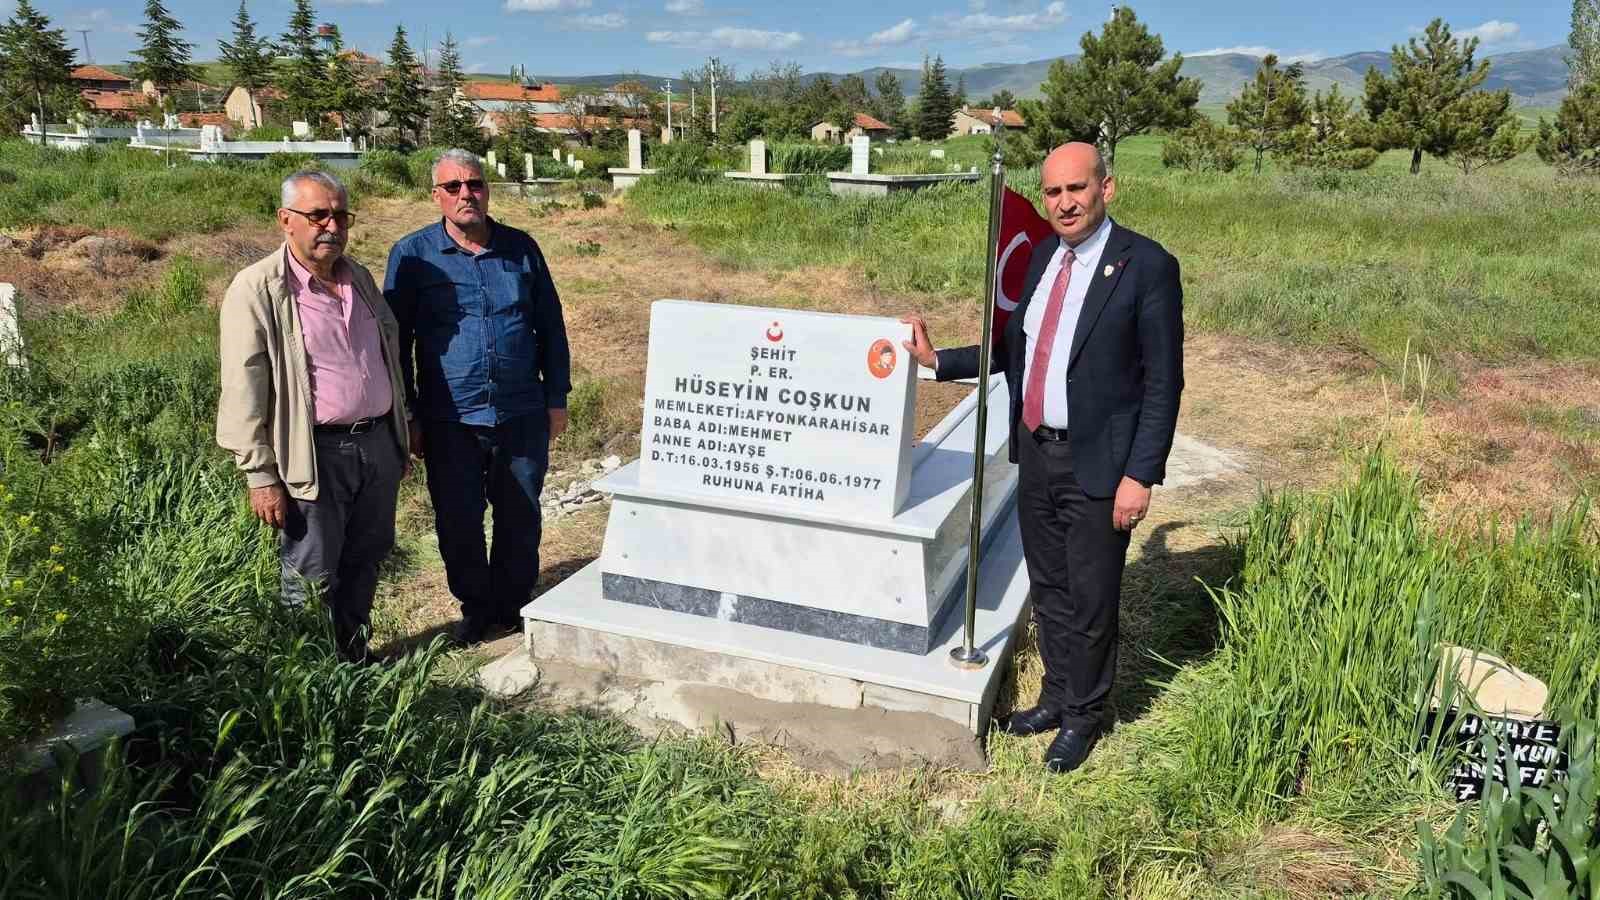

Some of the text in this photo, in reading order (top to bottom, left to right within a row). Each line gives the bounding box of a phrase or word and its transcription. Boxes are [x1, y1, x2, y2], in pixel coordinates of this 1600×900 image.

[751, 345, 796, 361] ŞEHİT
[751, 366, 793, 380] P. ER.
[675, 374, 871, 412] HÜSEYİN COŞKUN
[654, 417, 792, 442] BABA ADI:MEHMET
[655, 398, 889, 435] MEMLEKETİ:AFYONKARAHİSAR
[652, 433, 766, 457] ANNE ADI:AYŞE
[651, 450, 881, 490] D.T:16.03.1956 Ş.T:06.06.1977
[703, 474, 824, 501] RUHUNA FATİHA
